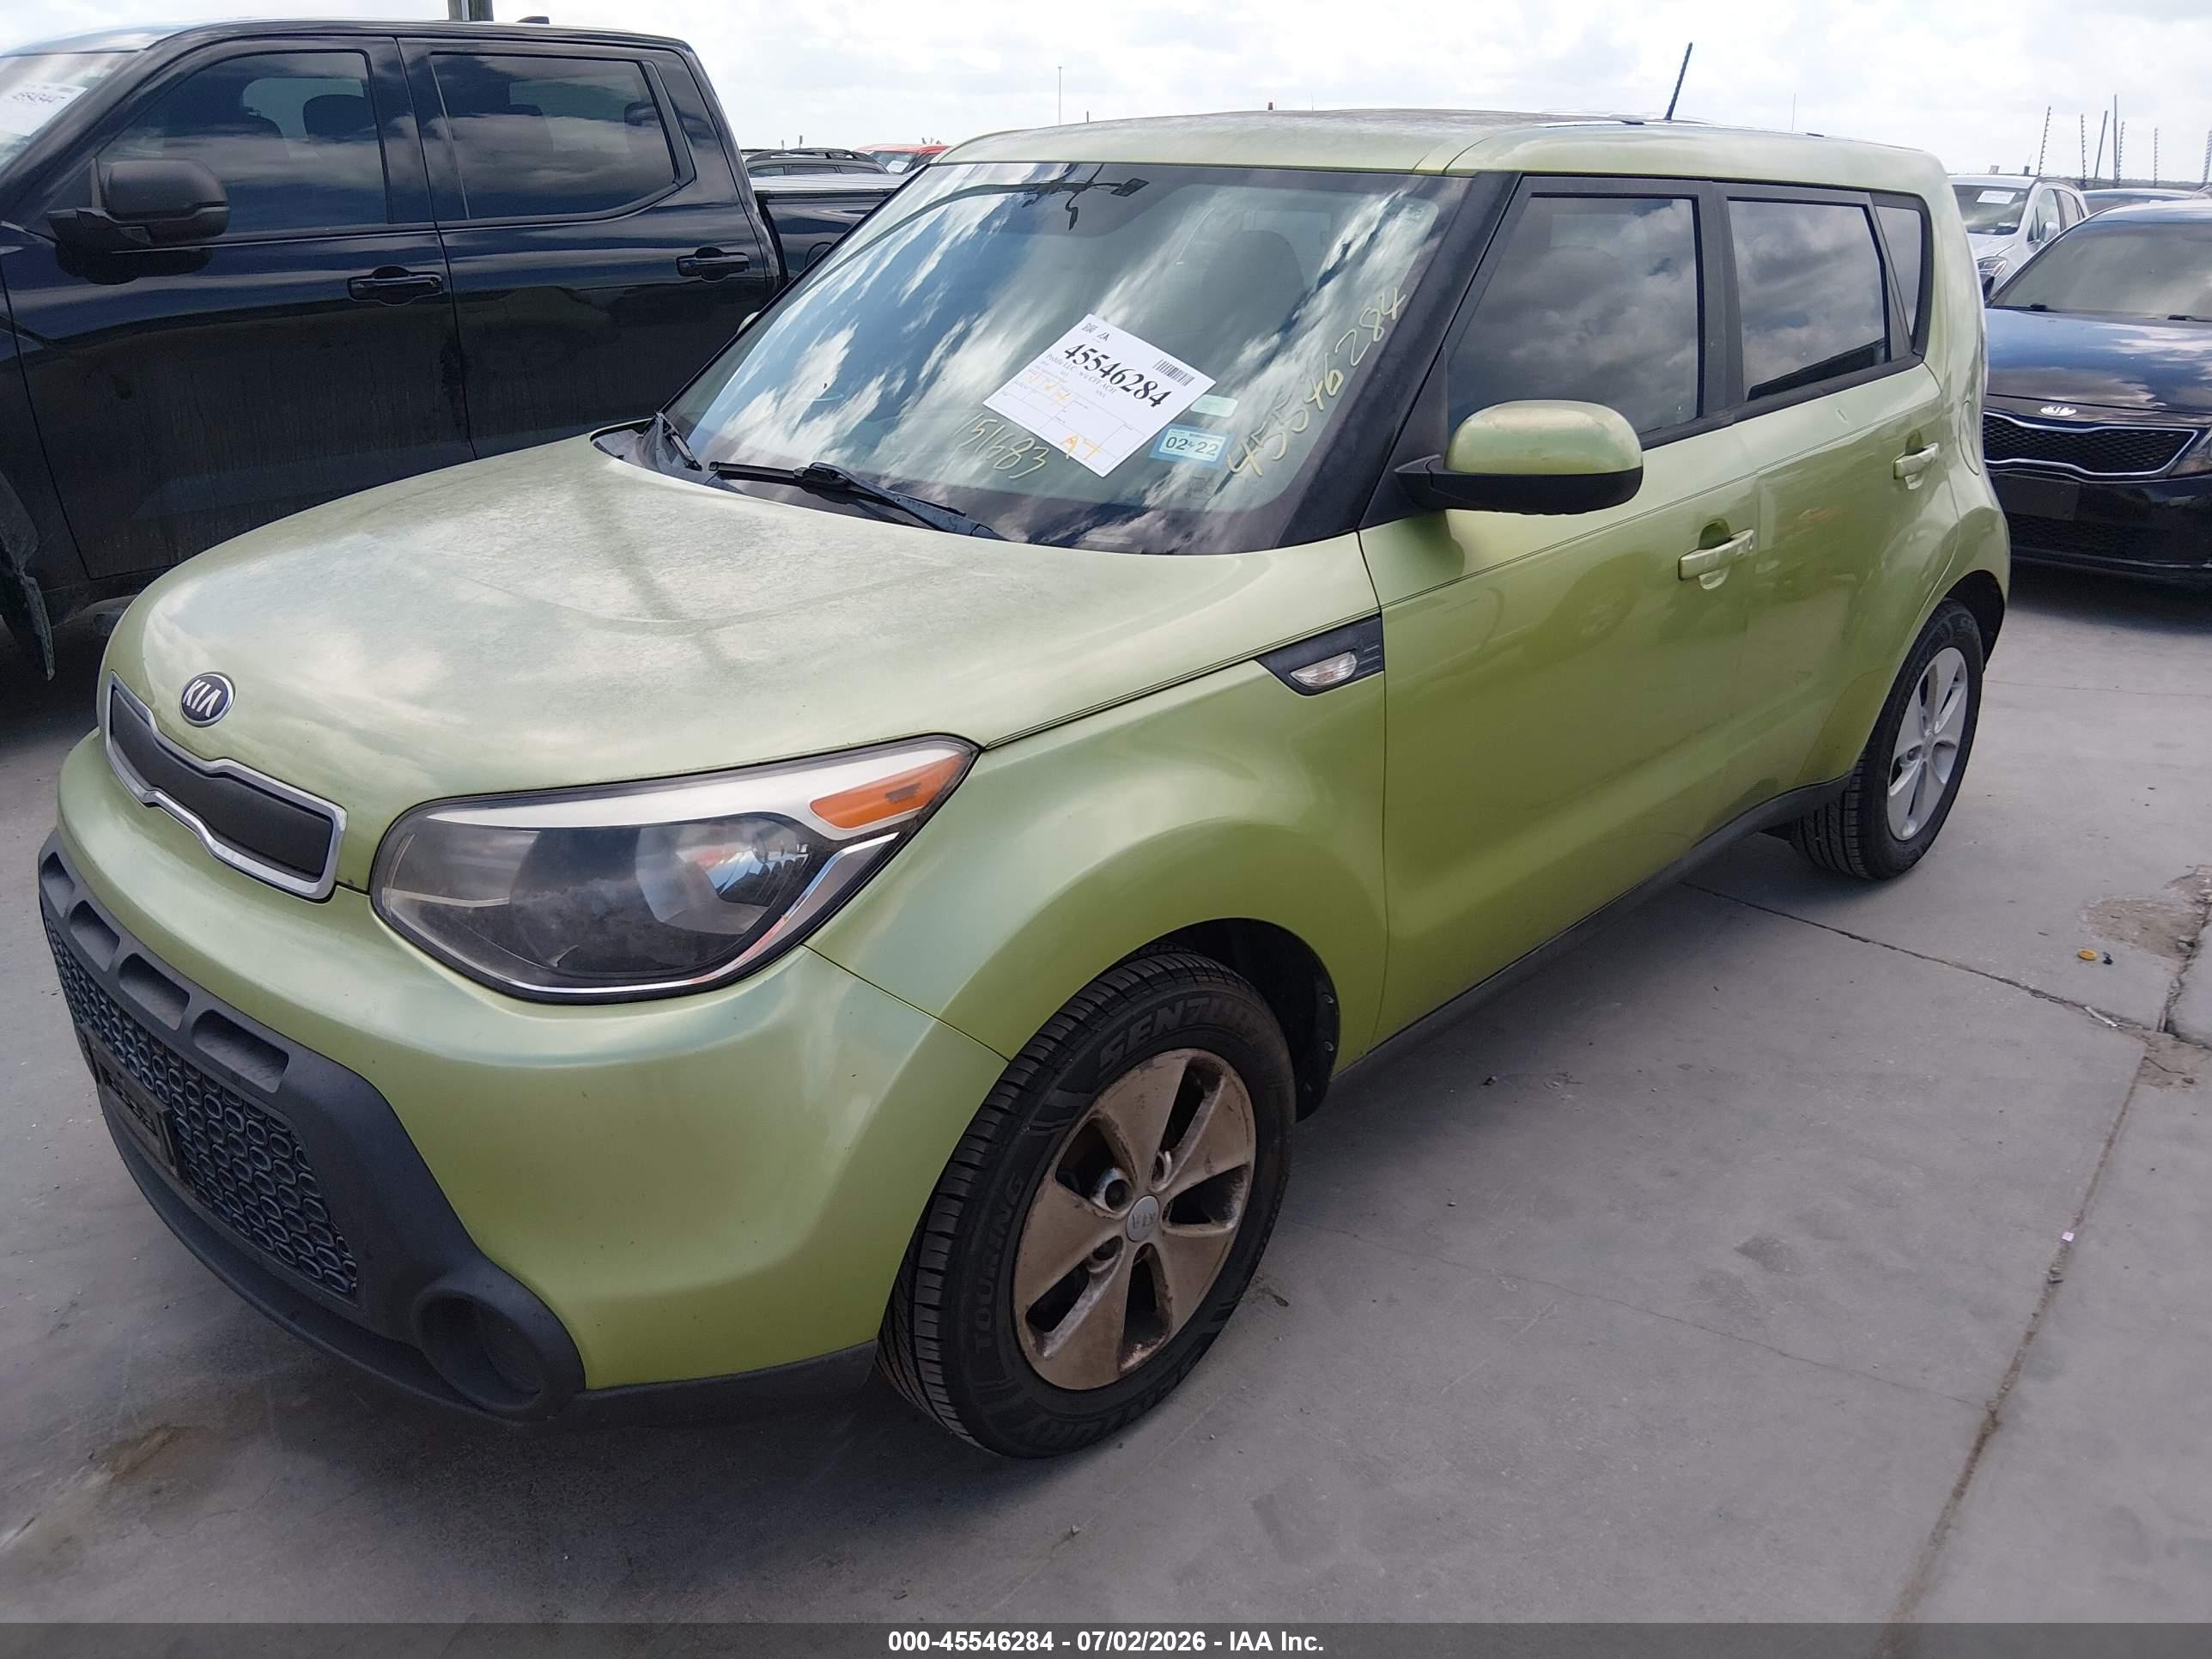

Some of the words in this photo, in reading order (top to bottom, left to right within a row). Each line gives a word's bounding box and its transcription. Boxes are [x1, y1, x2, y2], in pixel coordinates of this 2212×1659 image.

[1064, 343, 1173, 408] 45546284
[1166, 436, 1188, 451] 02
[1194, 441, 1218, 456] 22
[183, 679, 222, 718] KIA
